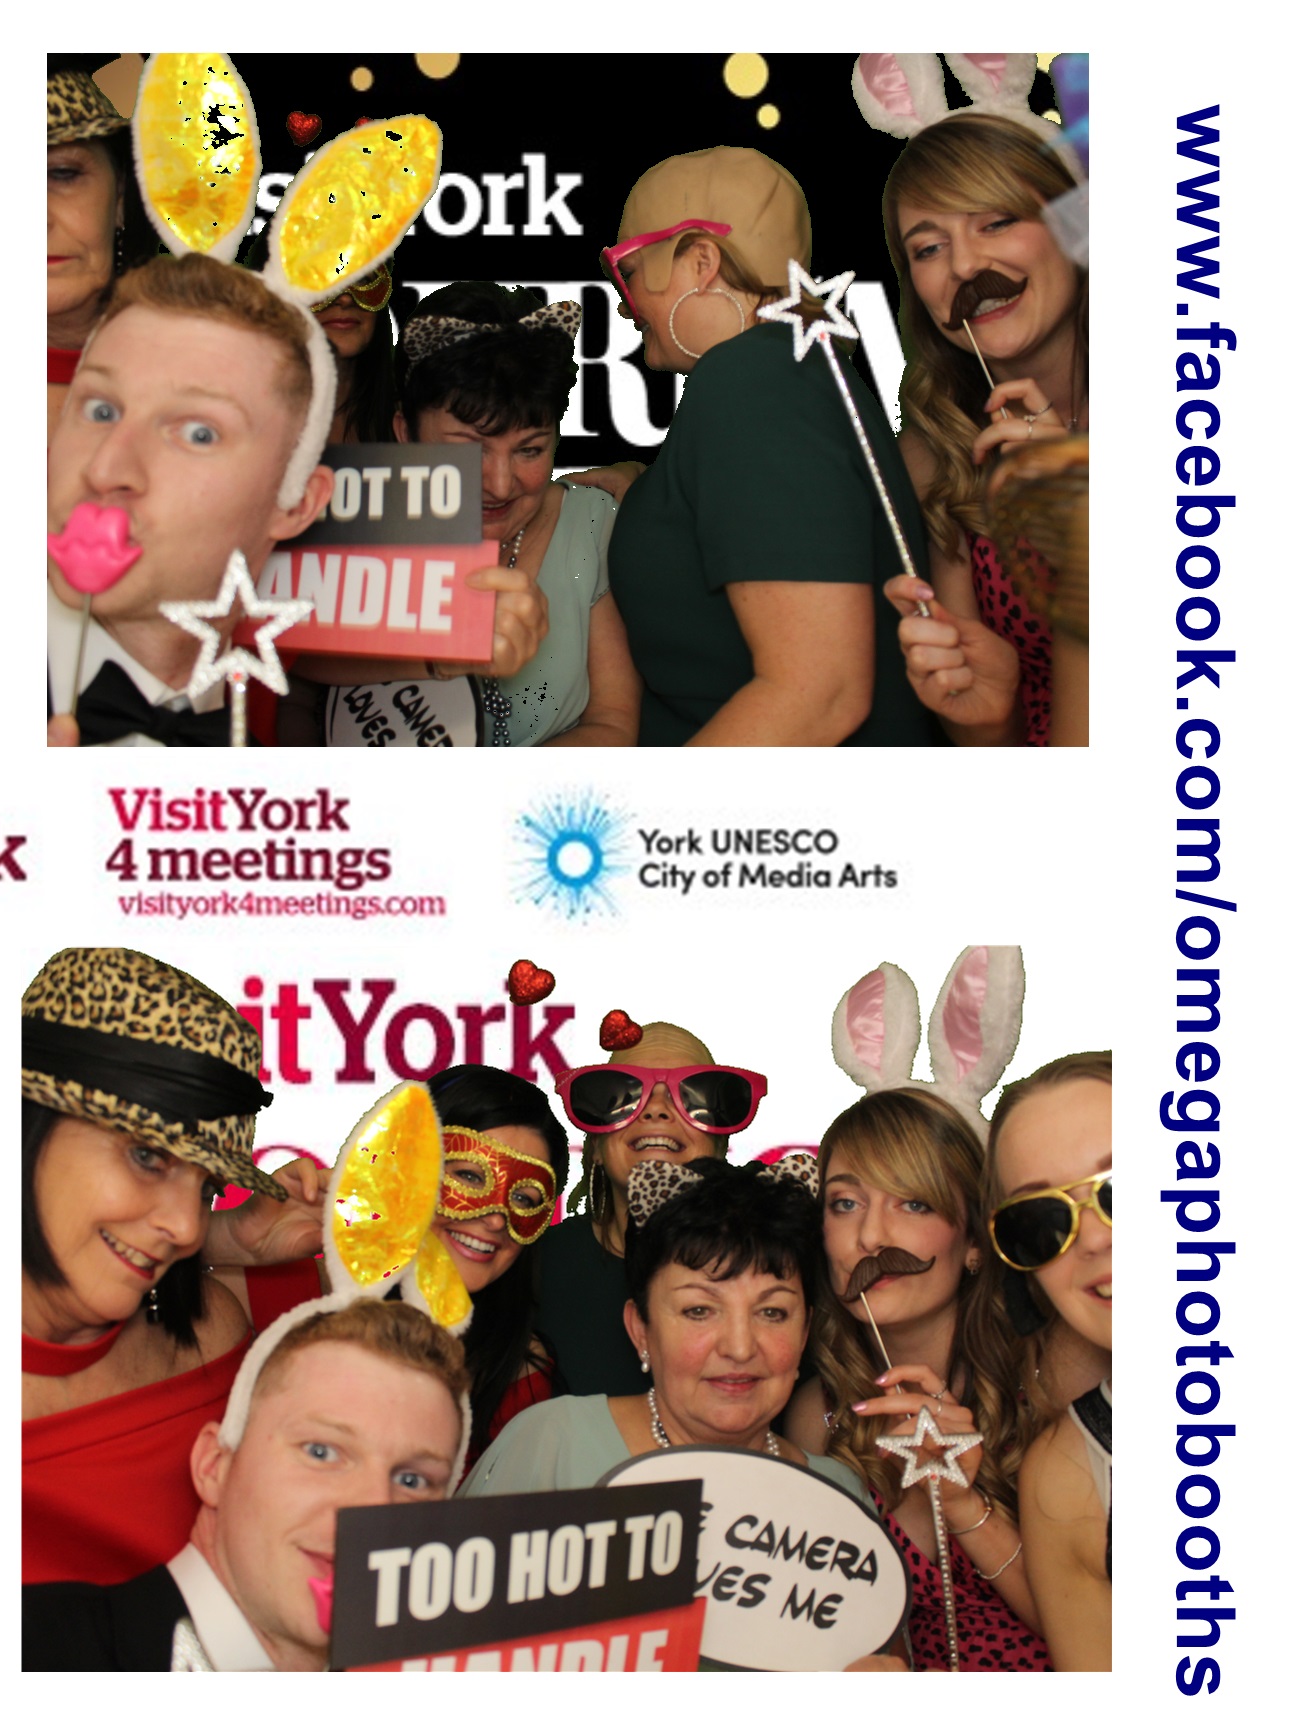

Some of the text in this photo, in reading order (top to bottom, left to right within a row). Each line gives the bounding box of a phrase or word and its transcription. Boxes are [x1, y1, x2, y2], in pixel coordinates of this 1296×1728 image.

[314, 464, 461, 520] OT TO
[244, 552, 455, 632] ANDLE
[367, 1510, 684, 1628] TOO HOT TO
[724, 1514, 878, 1587] CAMERA
[779, 1583, 844, 1629] ME
